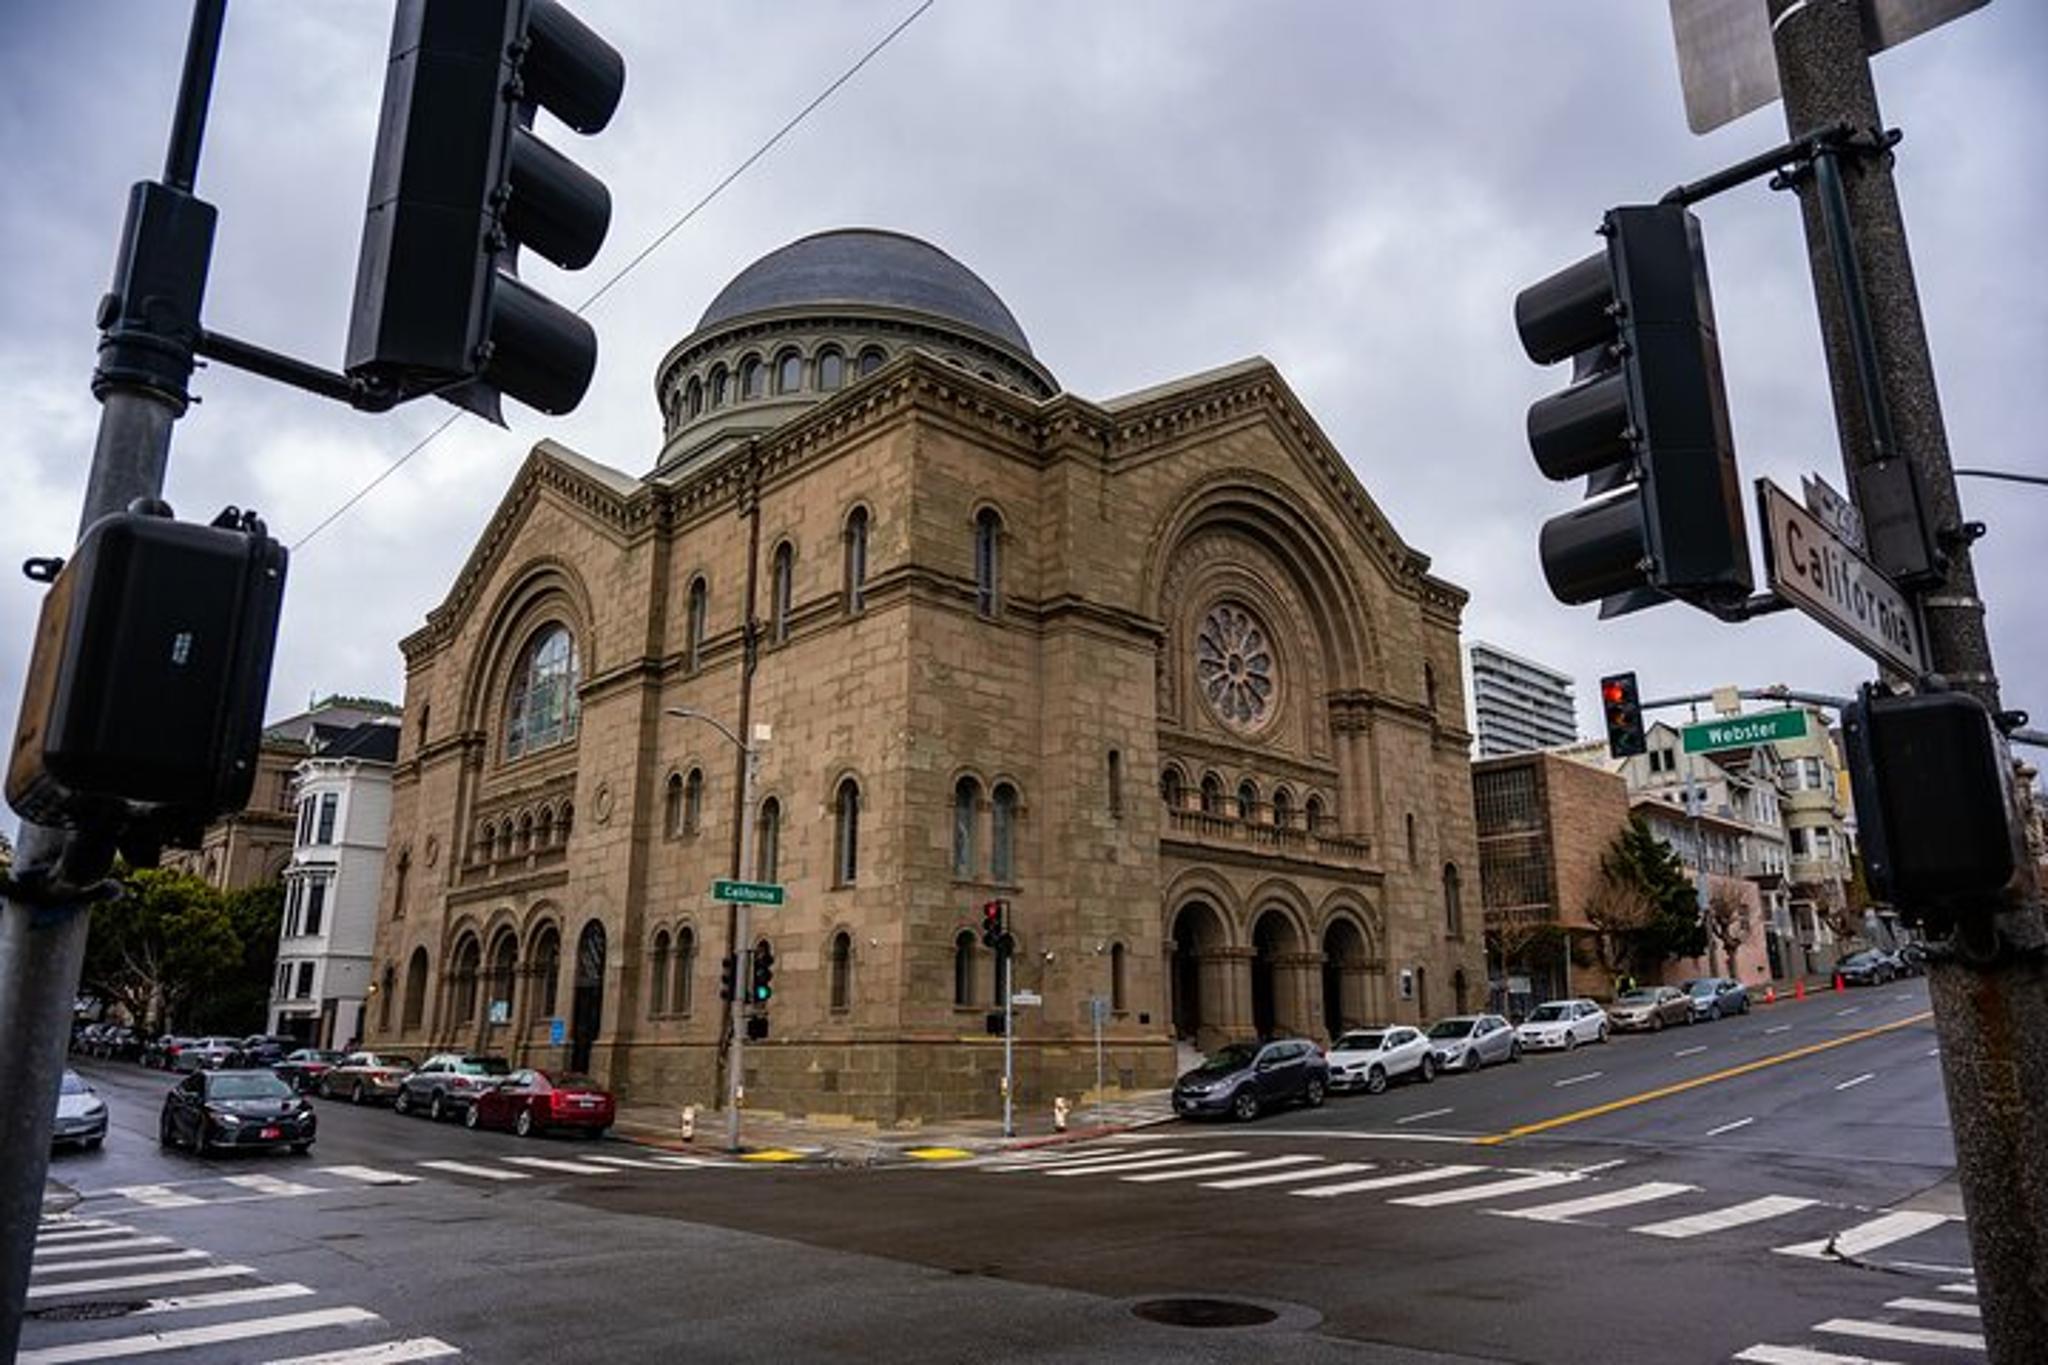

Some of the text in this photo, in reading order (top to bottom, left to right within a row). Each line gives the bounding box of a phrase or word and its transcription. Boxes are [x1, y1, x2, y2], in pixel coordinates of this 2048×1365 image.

[1786, 519, 1913, 655] California
[1708, 722, 1776, 743] Webster
[724, 886, 775, 900] California
